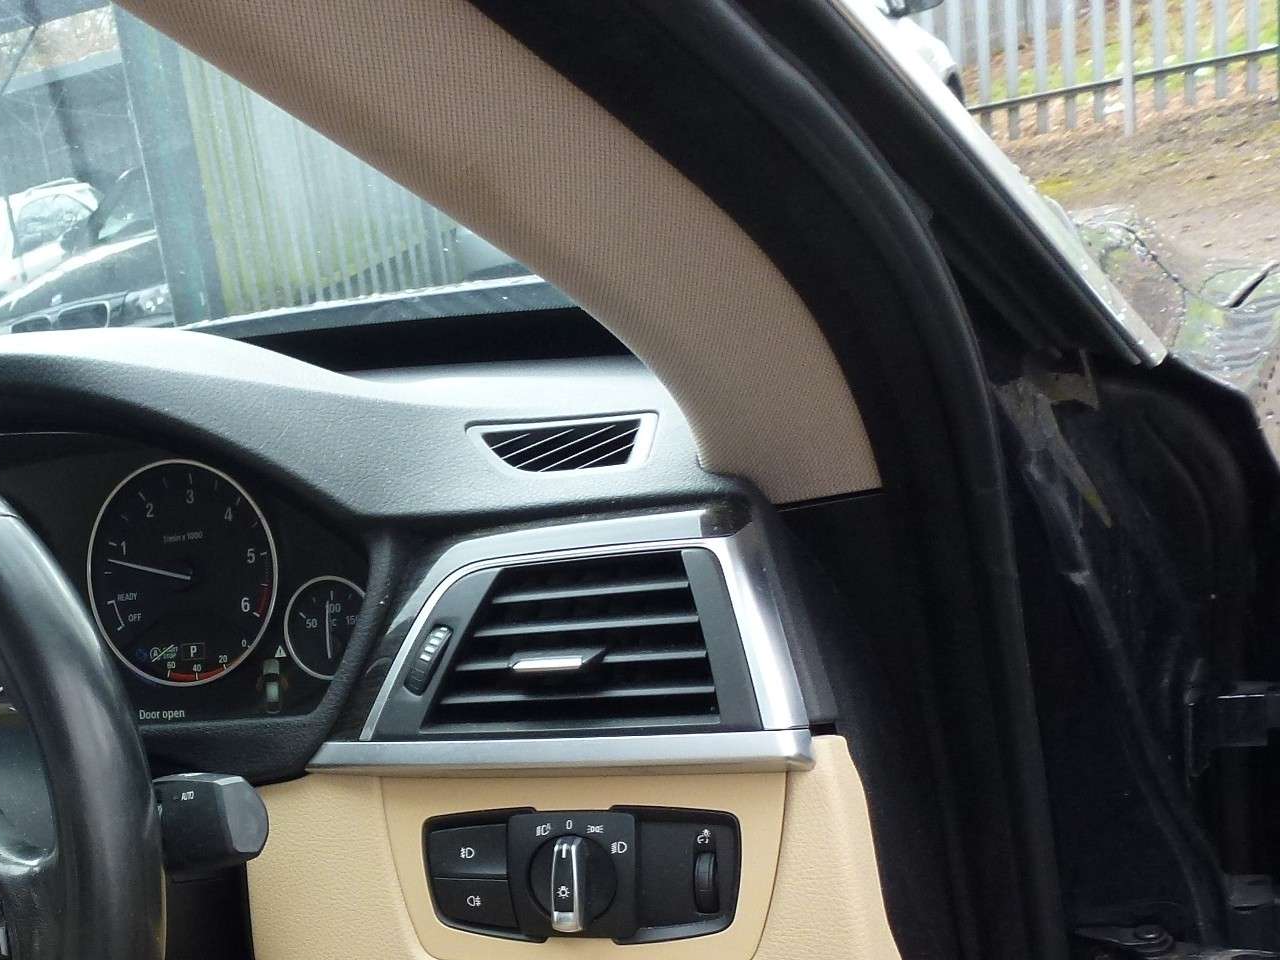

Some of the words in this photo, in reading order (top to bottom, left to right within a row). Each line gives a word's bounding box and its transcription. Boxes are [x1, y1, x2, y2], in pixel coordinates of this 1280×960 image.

[185, 489, 195, 504] 3
[145, 503, 155, 518] 2
[224, 507, 234, 521] 4
[121, 541, 127, 555] 1
[246, 548, 256, 563] 5
[240, 597, 250, 612] 6
[128, 613, 142, 622] OFF
[305, 618, 318, 629] 50
[190, 646, 197, 658] P
[218, 655, 228, 664] 20
[192, 663, 202, 672] 40
[139, 709, 160, 720] Door
[162, 710, 185, 721] open
